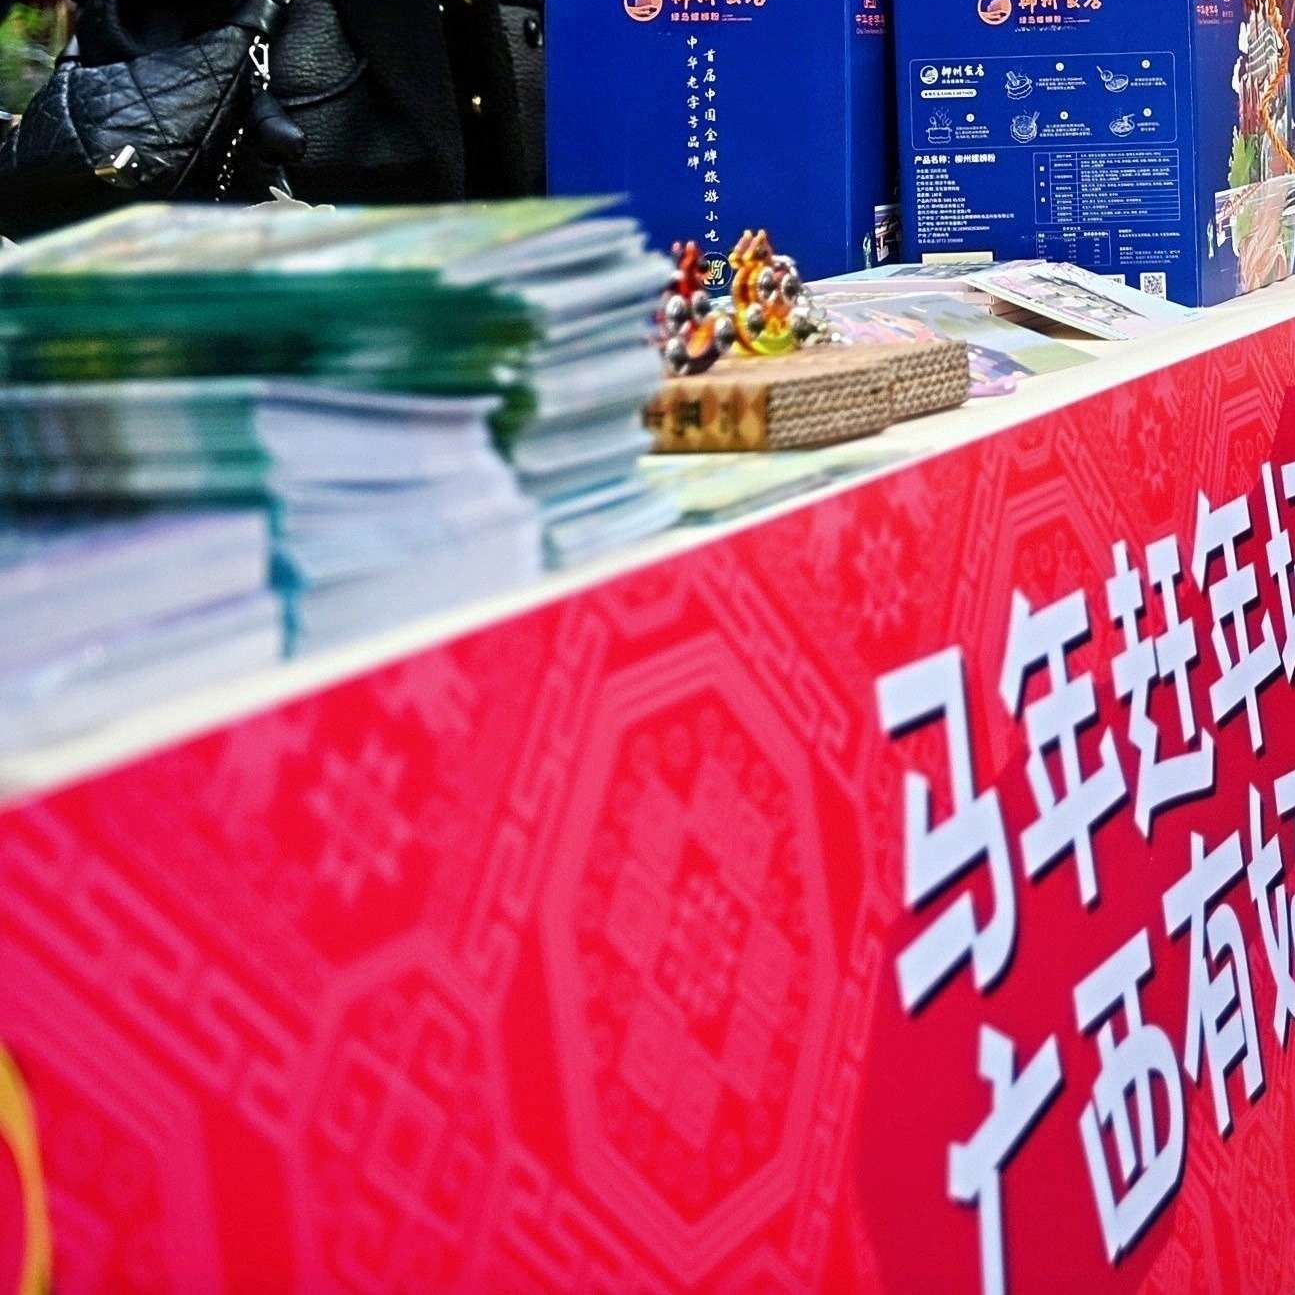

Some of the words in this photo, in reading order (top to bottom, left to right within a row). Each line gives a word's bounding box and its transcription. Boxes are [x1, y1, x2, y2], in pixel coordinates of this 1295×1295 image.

[685, 35, 700, 171] 中华老字号品牌
[703, 48, 720, 243] 首届中国金牌旅游小吃
